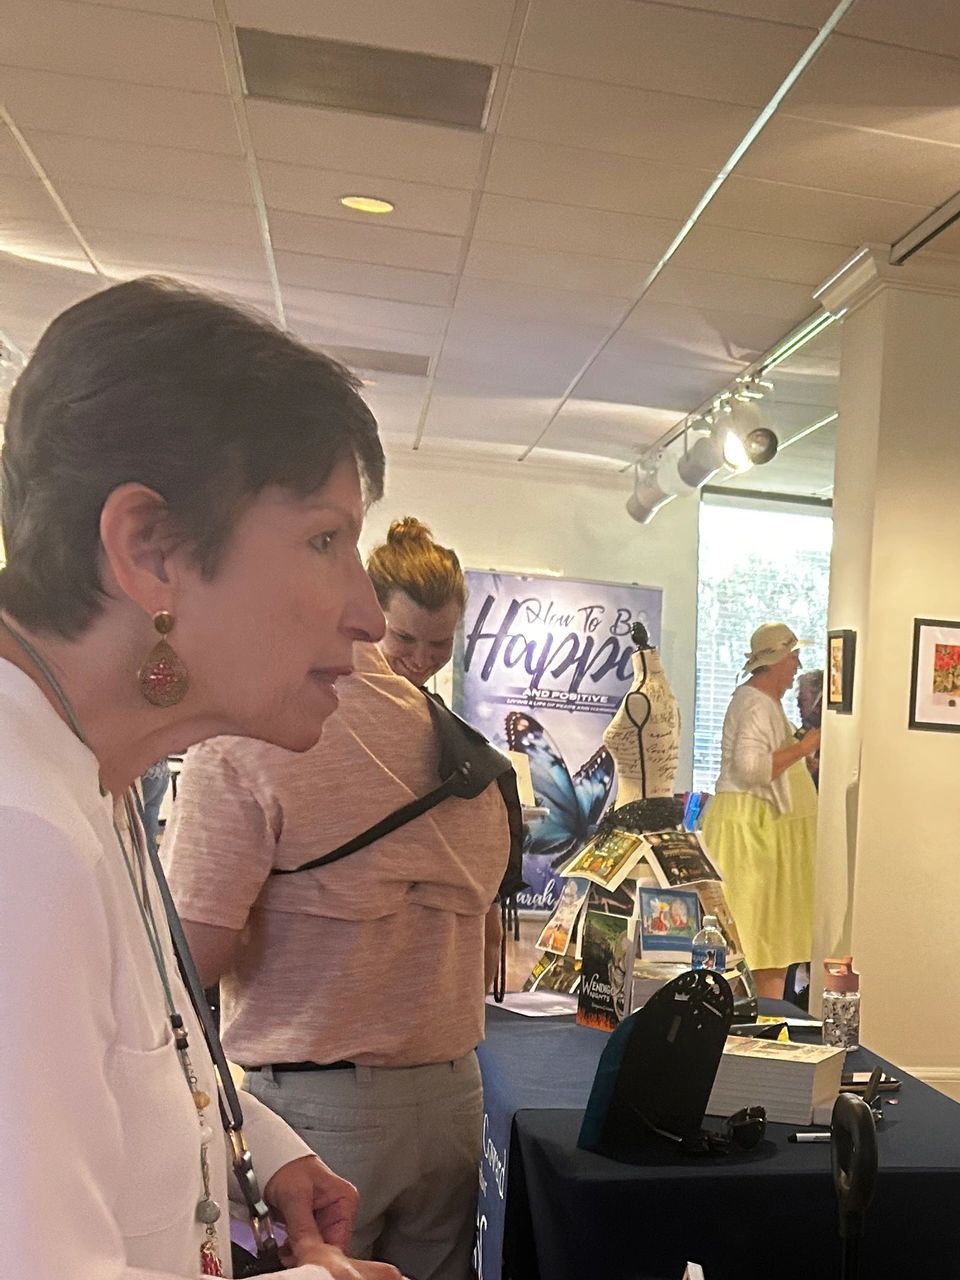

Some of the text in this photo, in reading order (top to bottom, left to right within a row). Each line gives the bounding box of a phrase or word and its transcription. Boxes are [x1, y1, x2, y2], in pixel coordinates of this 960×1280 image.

[577, 604, 605, 633] To
[609, 608, 633, 637] B
[523, 688, 609, 704] AND POSITIVE
[507, 878, 556, 906] arah
